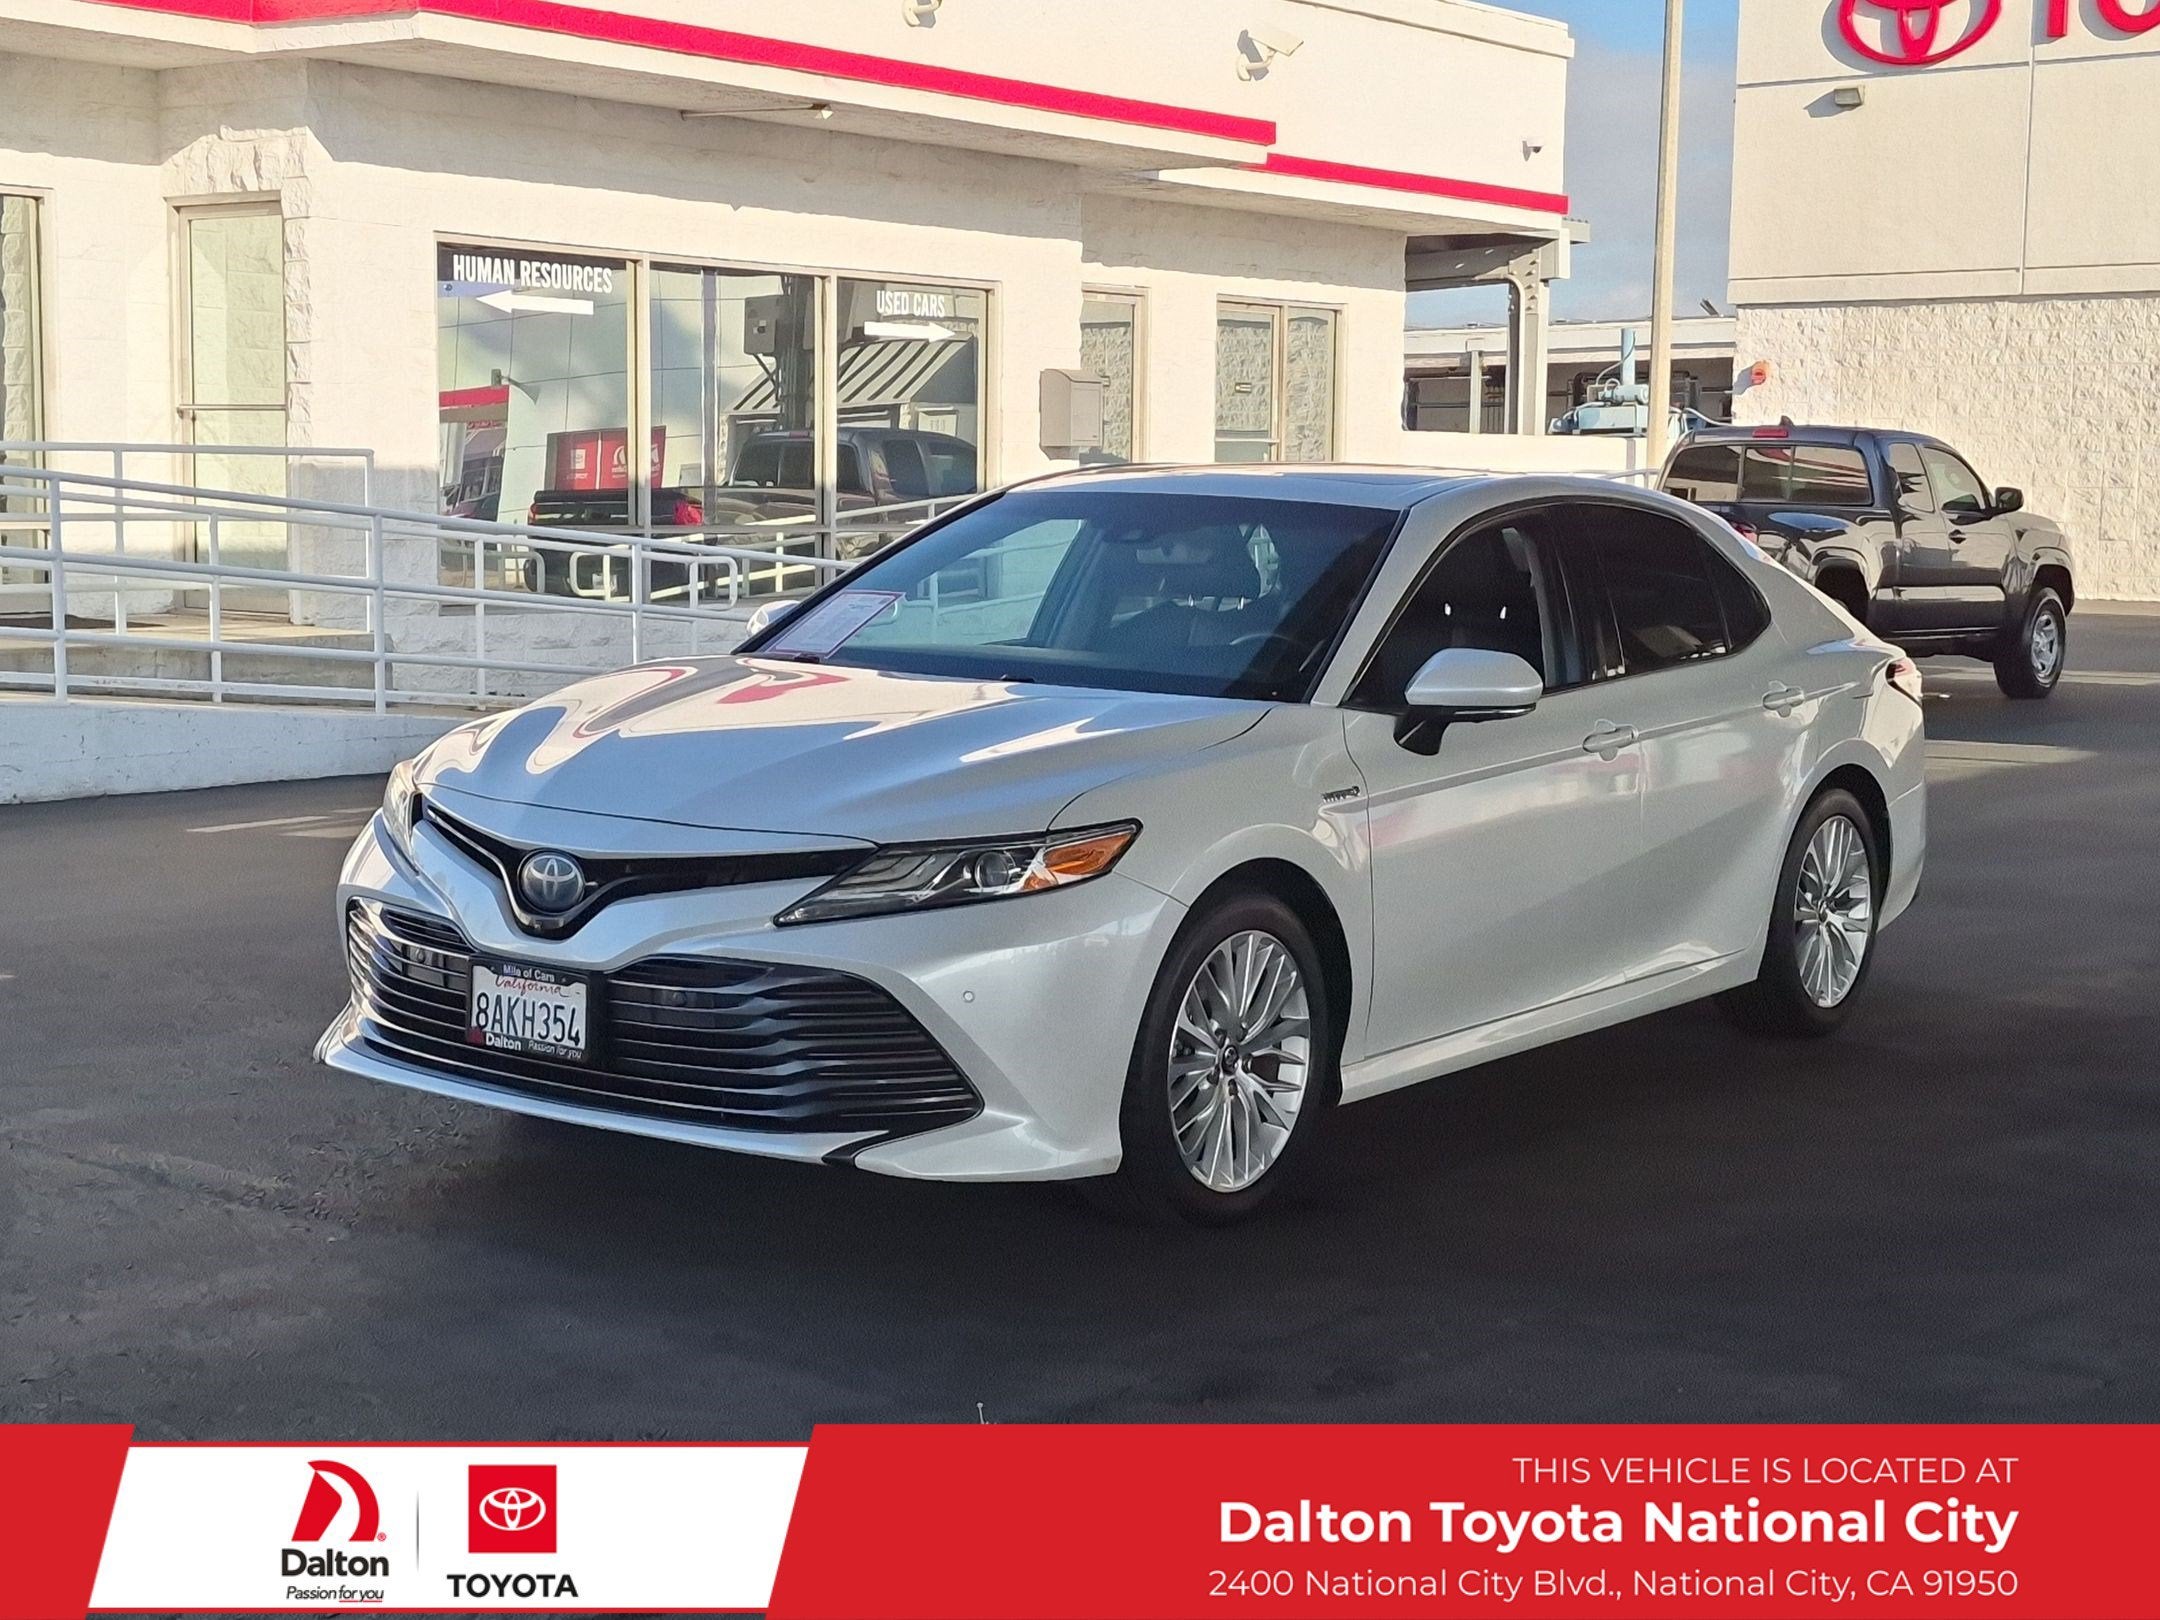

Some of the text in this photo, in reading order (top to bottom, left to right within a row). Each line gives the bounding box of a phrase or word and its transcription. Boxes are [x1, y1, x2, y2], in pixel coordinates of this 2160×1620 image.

[453, 254, 613, 294] HUMAN RESOURCES
[876, 290, 946, 318] USED CARS
[495, 975, 570, 997] California
[503, 964, 555, 982] Mile of Cars
[475, 992, 581, 1047] 8AKH354
[485, 1032, 582, 1060] Dalton Passion for you
